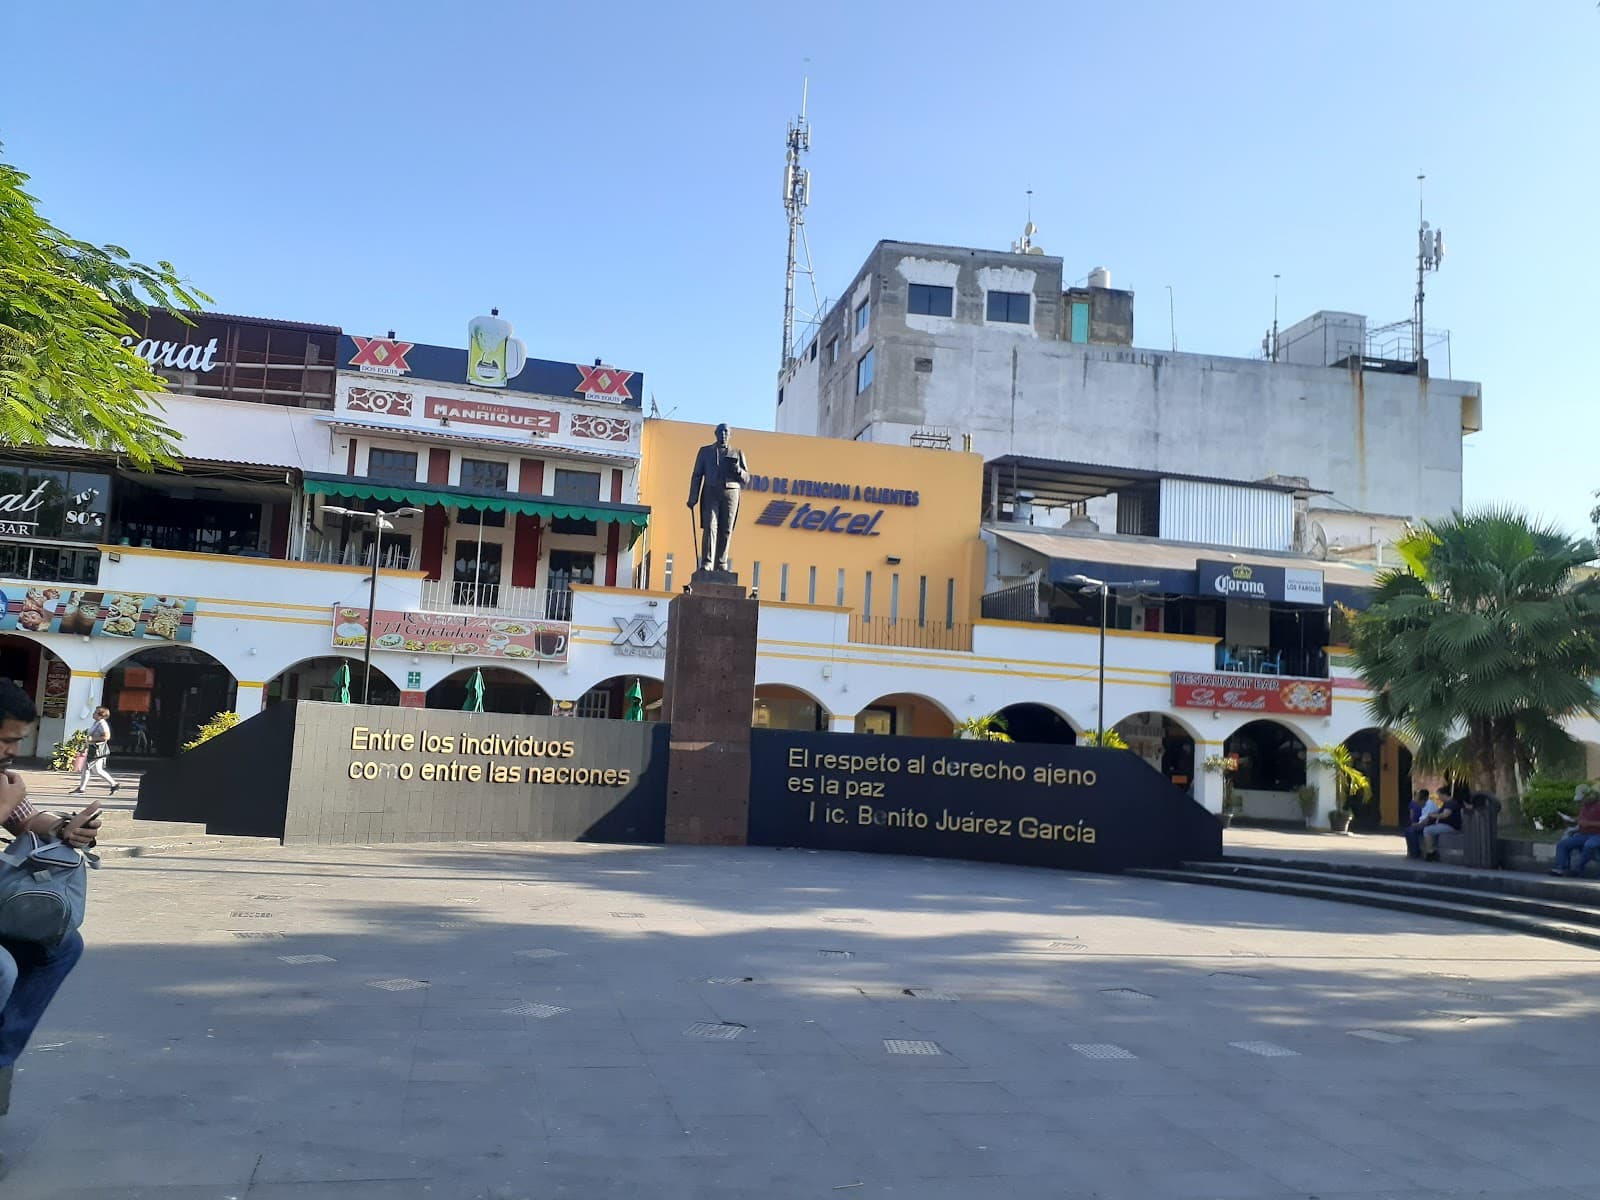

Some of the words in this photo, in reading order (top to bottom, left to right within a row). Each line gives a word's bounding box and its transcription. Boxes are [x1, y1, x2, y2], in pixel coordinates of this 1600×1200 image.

[433, 404, 552, 428] MANRIQUEZ
[772, 477, 789, 495] DE
[791, 479, 850, 501] ATENCION
[852, 485, 862, 501] A
[864, 486, 920, 507] CLIENTES
[790, 502, 884, 536] telcel
[1214, 574, 1266, 595] Corona
[1176, 672, 1251, 689] RESTAURANT
[1254, 678, 1279, 691] BAR
[350, 727, 415, 751] Entre
[420, 730, 455, 754] los
[460, 733, 575, 758] individuos
[349, 760, 413, 781] como
[420, 759, 482, 783] entre
[487, 761, 522, 784] las
[526, 766, 631, 786] naciones
[788, 748, 808, 768] El
[815, 753, 901, 774] respeto
[907, 755, 926, 774] al
[932, 756, 1026, 781] derecho
[1033, 763, 1097, 787] ajeno
[788, 776, 815, 793] es
[820, 775, 839, 795] la
[845, 780, 886, 799] paz
[858, 805, 928, 829] Benito
[935, 809, 1012, 836] Juárez
[1018, 817, 1096, 844] García
